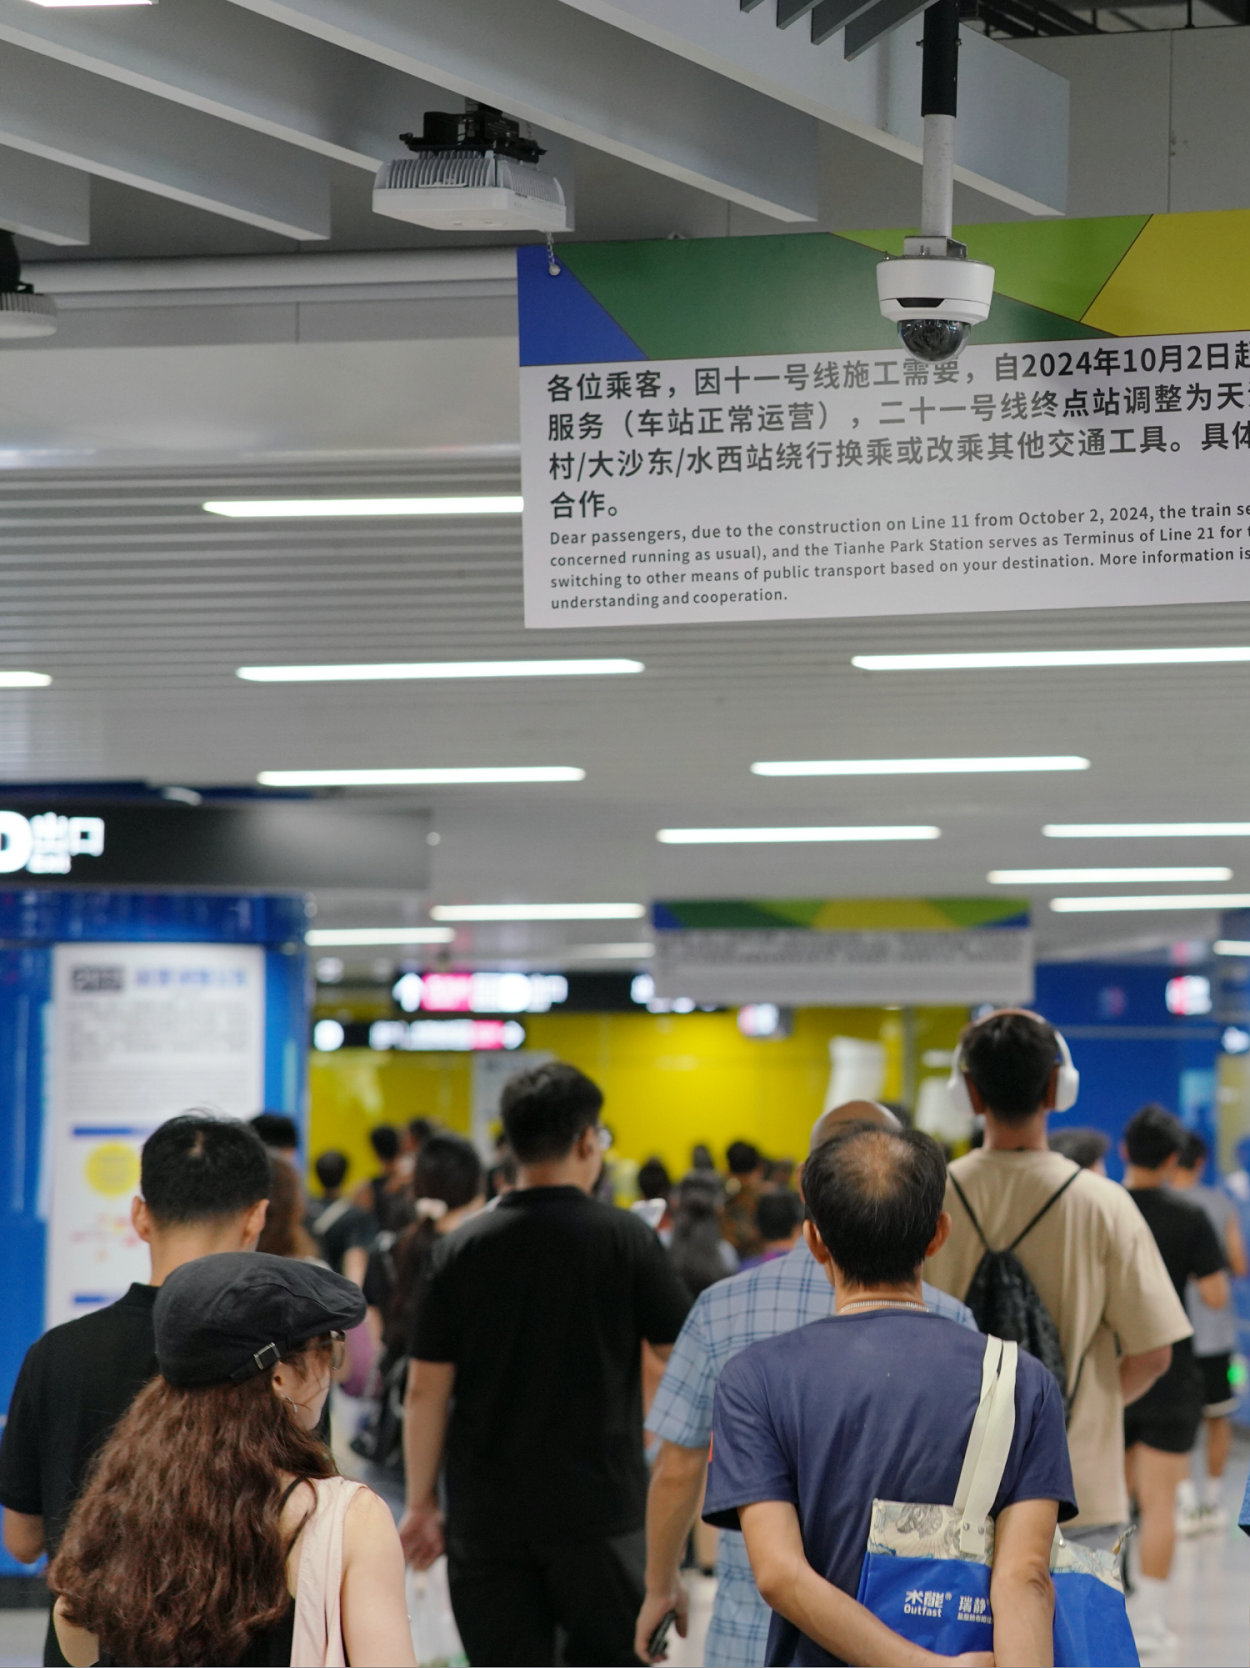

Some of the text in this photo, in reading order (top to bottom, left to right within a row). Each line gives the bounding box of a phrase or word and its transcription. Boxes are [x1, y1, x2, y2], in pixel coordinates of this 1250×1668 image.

[549, 531, 587, 545] Dear
[591, 529, 686, 547] passengers,
[691, 524, 721, 539] due
[725, 525, 742, 538] to
[746, 522, 774, 537] the
[778, 517, 881, 536] construction
[886, 519, 906, 531] on
[911, 515, 946, 530] Line
[951, 513, 969, 528] 11
[974, 512, 1013, 527] from
[1018, 509, 1085, 526] October
[1089, 508, 1104, 525] 2,
[1109, 506, 1154, 523] 2024,
[1158, 504, 1186, 519] the
[1190, 501, 1231, 518] train
[550, 490, 618, 520] 合作。
[549, 550, 626, 567] concerned
[631, 548, 690, 565] running
[694, 550, 711, 561] as
[715, 545, 766, 561] usual),
[771, 543, 799, 558] and
[804, 542, 829, 556] the
[833, 540, 885, 555] Tianhe
[890, 538, 924, 553] Park
[929, 536, 983, 552] Station
[988, 536, 1037, 549] serves
[1042, 536, 1059, 546] as
[1063, 530, 1134, 545] Terminus
[1139, 527, 1155, 542] of
[1159, 527, 1192, 542] Line
[1196, 526, 1214, 540] 21
[1219, 524, 1242, 539] for
[550, 573, 622, 589] switching
[626, 573, 642, 585] to
[646, 570, 686, 584] other
[690, 570, 739, 582] means
[743, 566, 759, 581] of
[763, 564, 809, 583] public
[814, 562, 886, 579] transport
[890, 559, 934, 575] based
[939, 561, 958, 572] on
[962, 560, 998, 575] your
[1001, 553, 1094, 570] destination.
[1099, 552, 1137, 566] More
[1141, 547, 1234, 564] information
[550, 587, 788, 610] understanding and cooperation.
